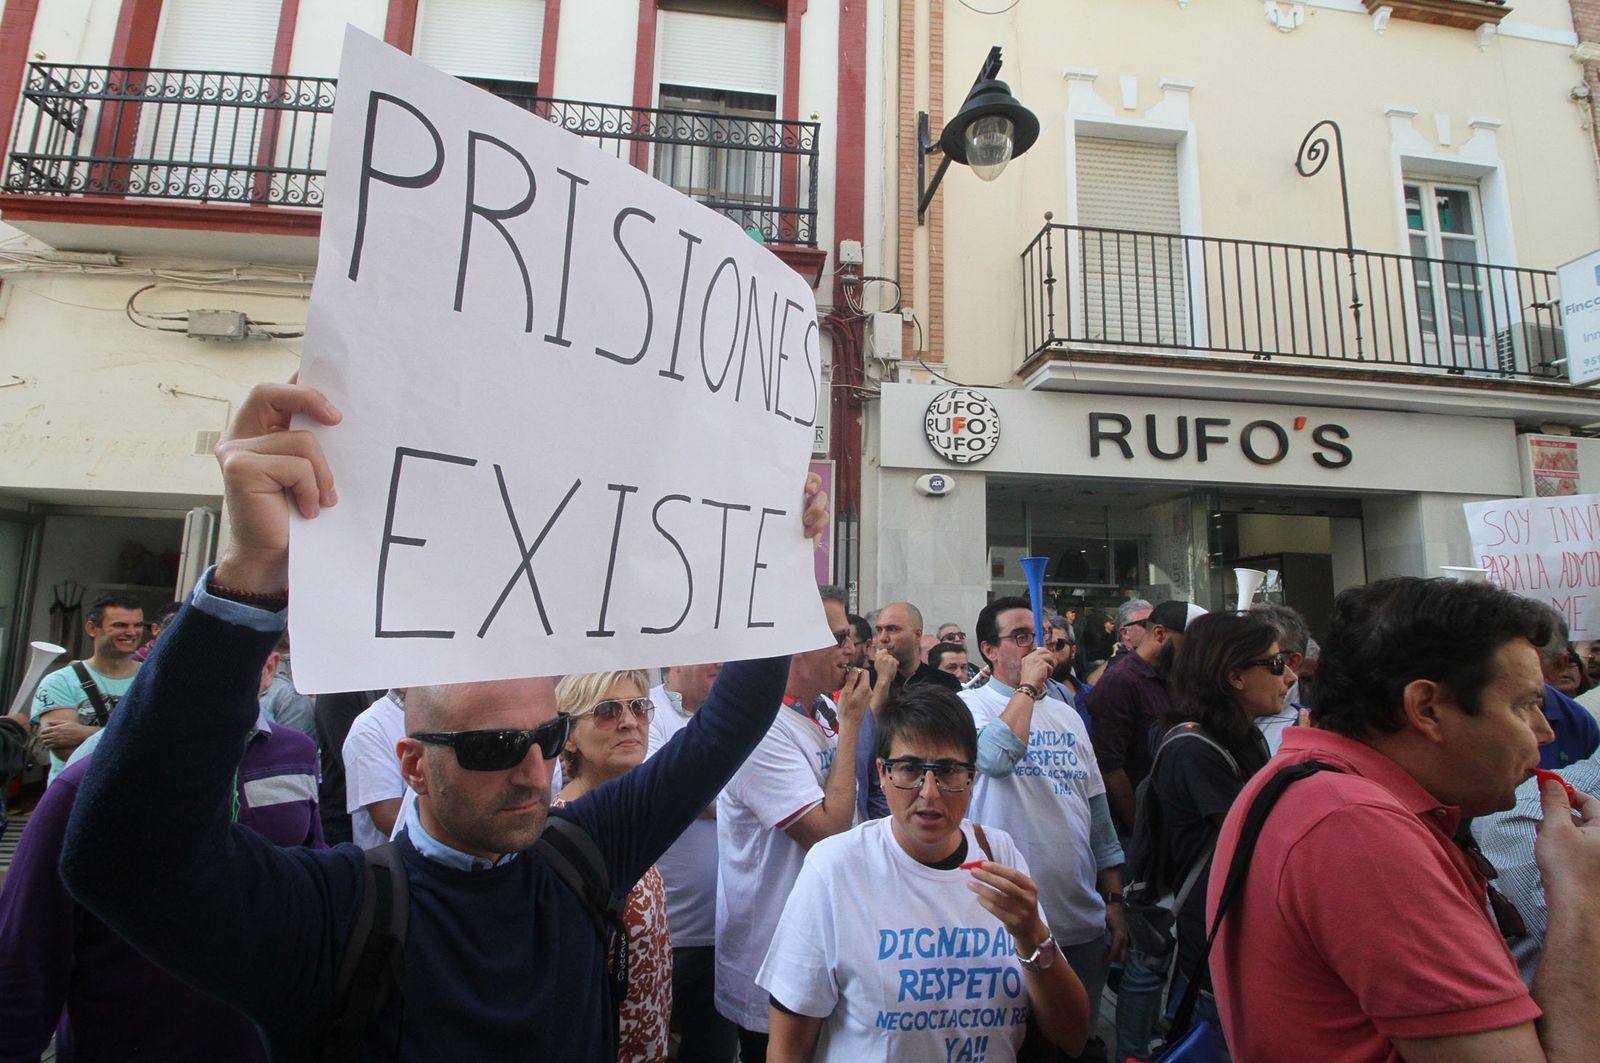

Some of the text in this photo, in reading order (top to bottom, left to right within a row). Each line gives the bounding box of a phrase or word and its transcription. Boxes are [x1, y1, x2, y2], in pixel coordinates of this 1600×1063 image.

[348, 90, 818, 427] PRISIONES
[927, 417, 998, 434] RUFO'S
[1089, 411, 1353, 469] RUFO'S
[375, 446, 787, 638] EXISTE
[1483, 508, 1530, 546] SOY
[1551, 595, 1588, 631] ME
[1029, 730, 1076, 748] GNIDAD
[898, 967, 1021, 1003] RESPETO
[875, 1007, 1007, 1032] NEGOCIACION
[944, 1036, 989, 1063] YA!!
